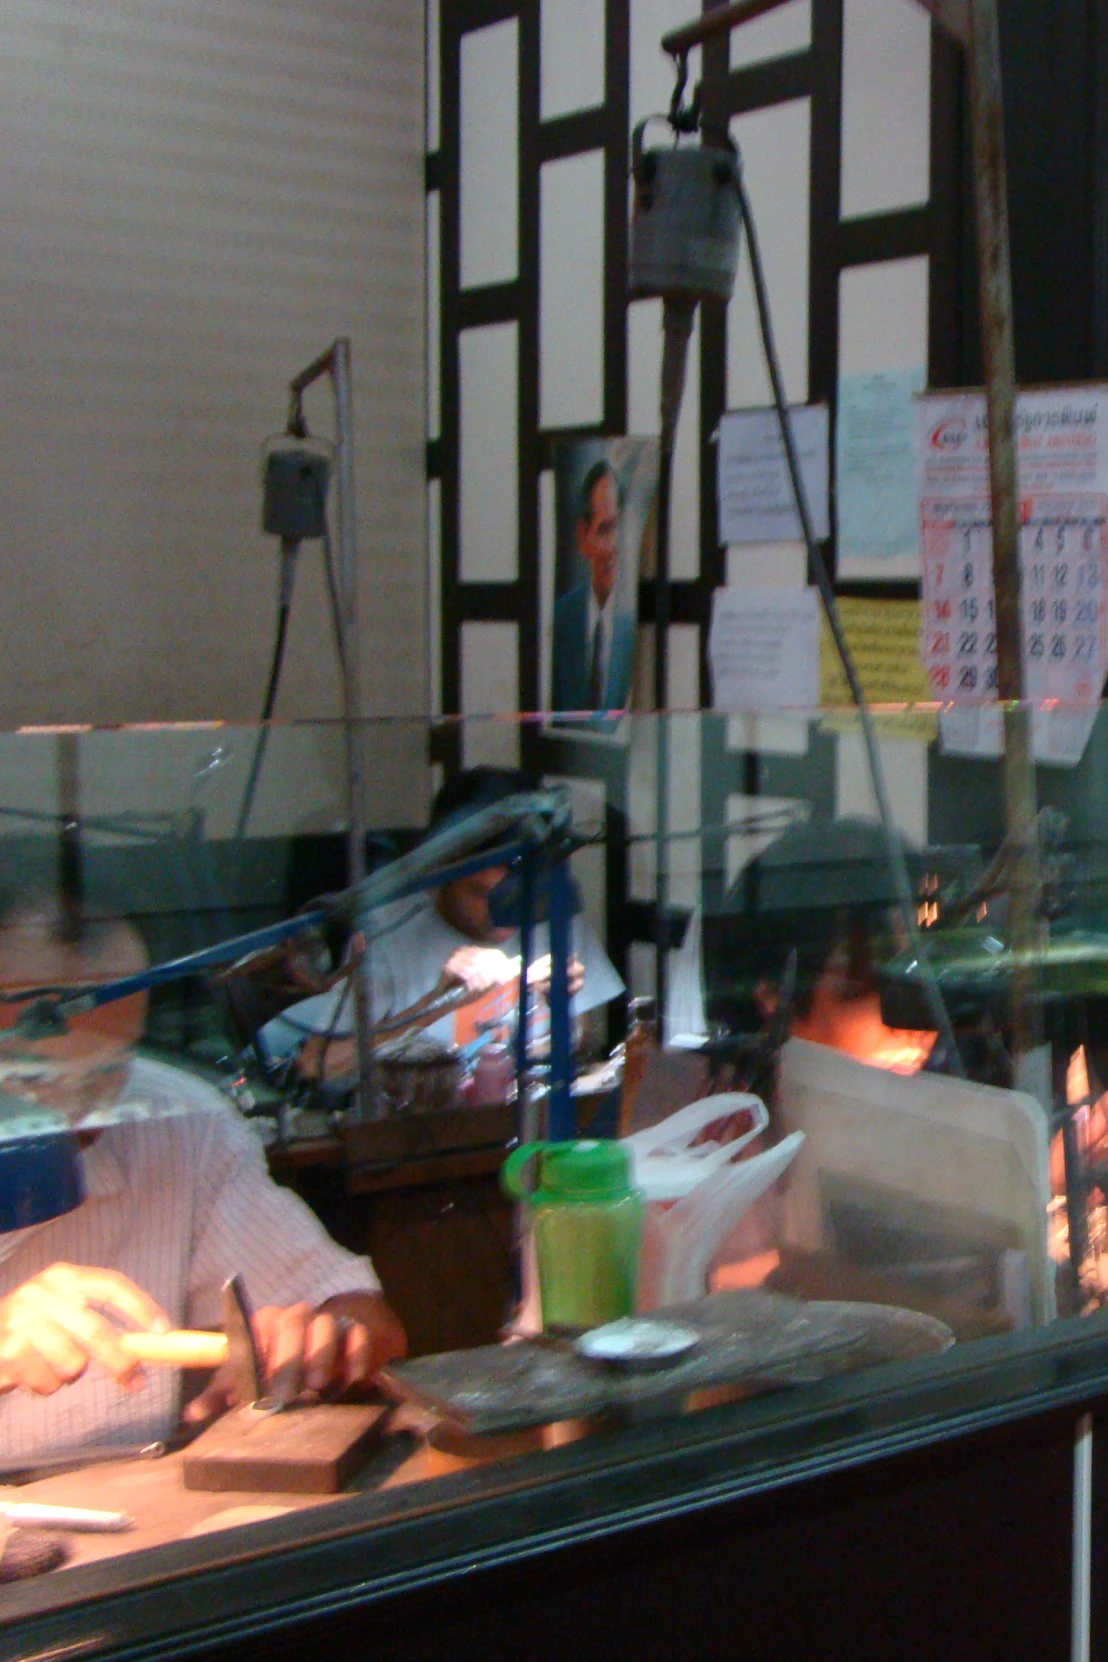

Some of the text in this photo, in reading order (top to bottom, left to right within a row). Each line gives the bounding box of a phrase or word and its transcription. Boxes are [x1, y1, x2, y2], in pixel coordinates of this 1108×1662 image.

[936, 562, 945, 585] 7
[963, 561, 974, 588] 8
[1031, 562, 1046, 587] 11
[1053, 561, 1068, 587] 12
[934, 599, 952, 619] 14
[961, 597, 979, 622] 15
[1031, 597, 1047, 623] 18
[1051, 597, 1067, 622] 19
[1074, 597, 1098, 623] 20
[931, 630, 950, 652] 21
[957, 631, 978, 655] 22
[1028, 631, 1045, 657] 25
[1049, 631, 1067, 658] 26
[1072, 634, 1097, 662] 27
[957, 665, 978, 690] 29
